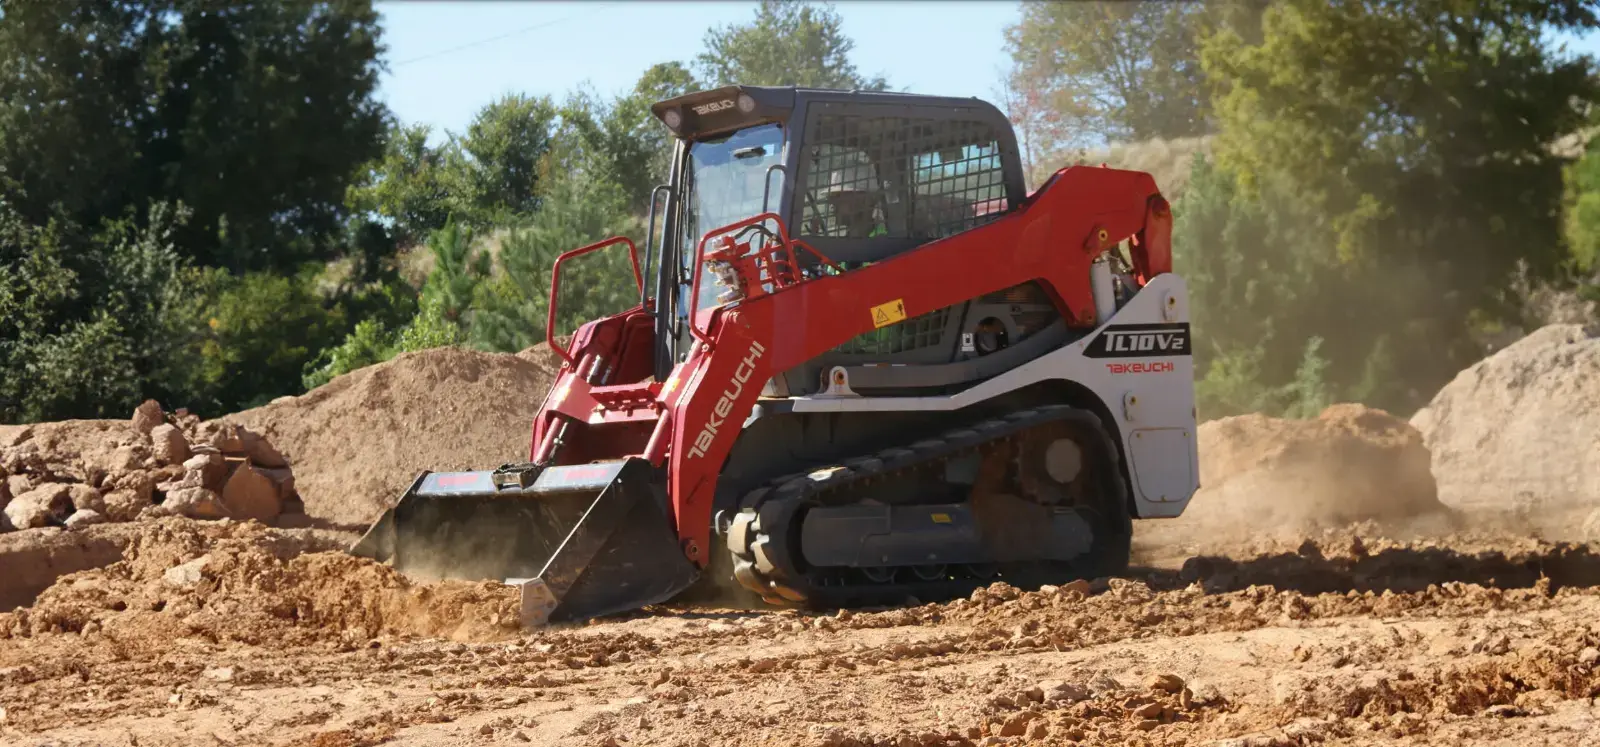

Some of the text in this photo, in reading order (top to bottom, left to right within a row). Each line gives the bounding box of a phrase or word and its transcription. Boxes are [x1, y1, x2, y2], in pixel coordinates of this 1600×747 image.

[1102, 328, 1185, 352] TL10V2
[1105, 361, 1175, 374] TAKEUCHI
[687, 340, 766, 459] TAKEUCHI
